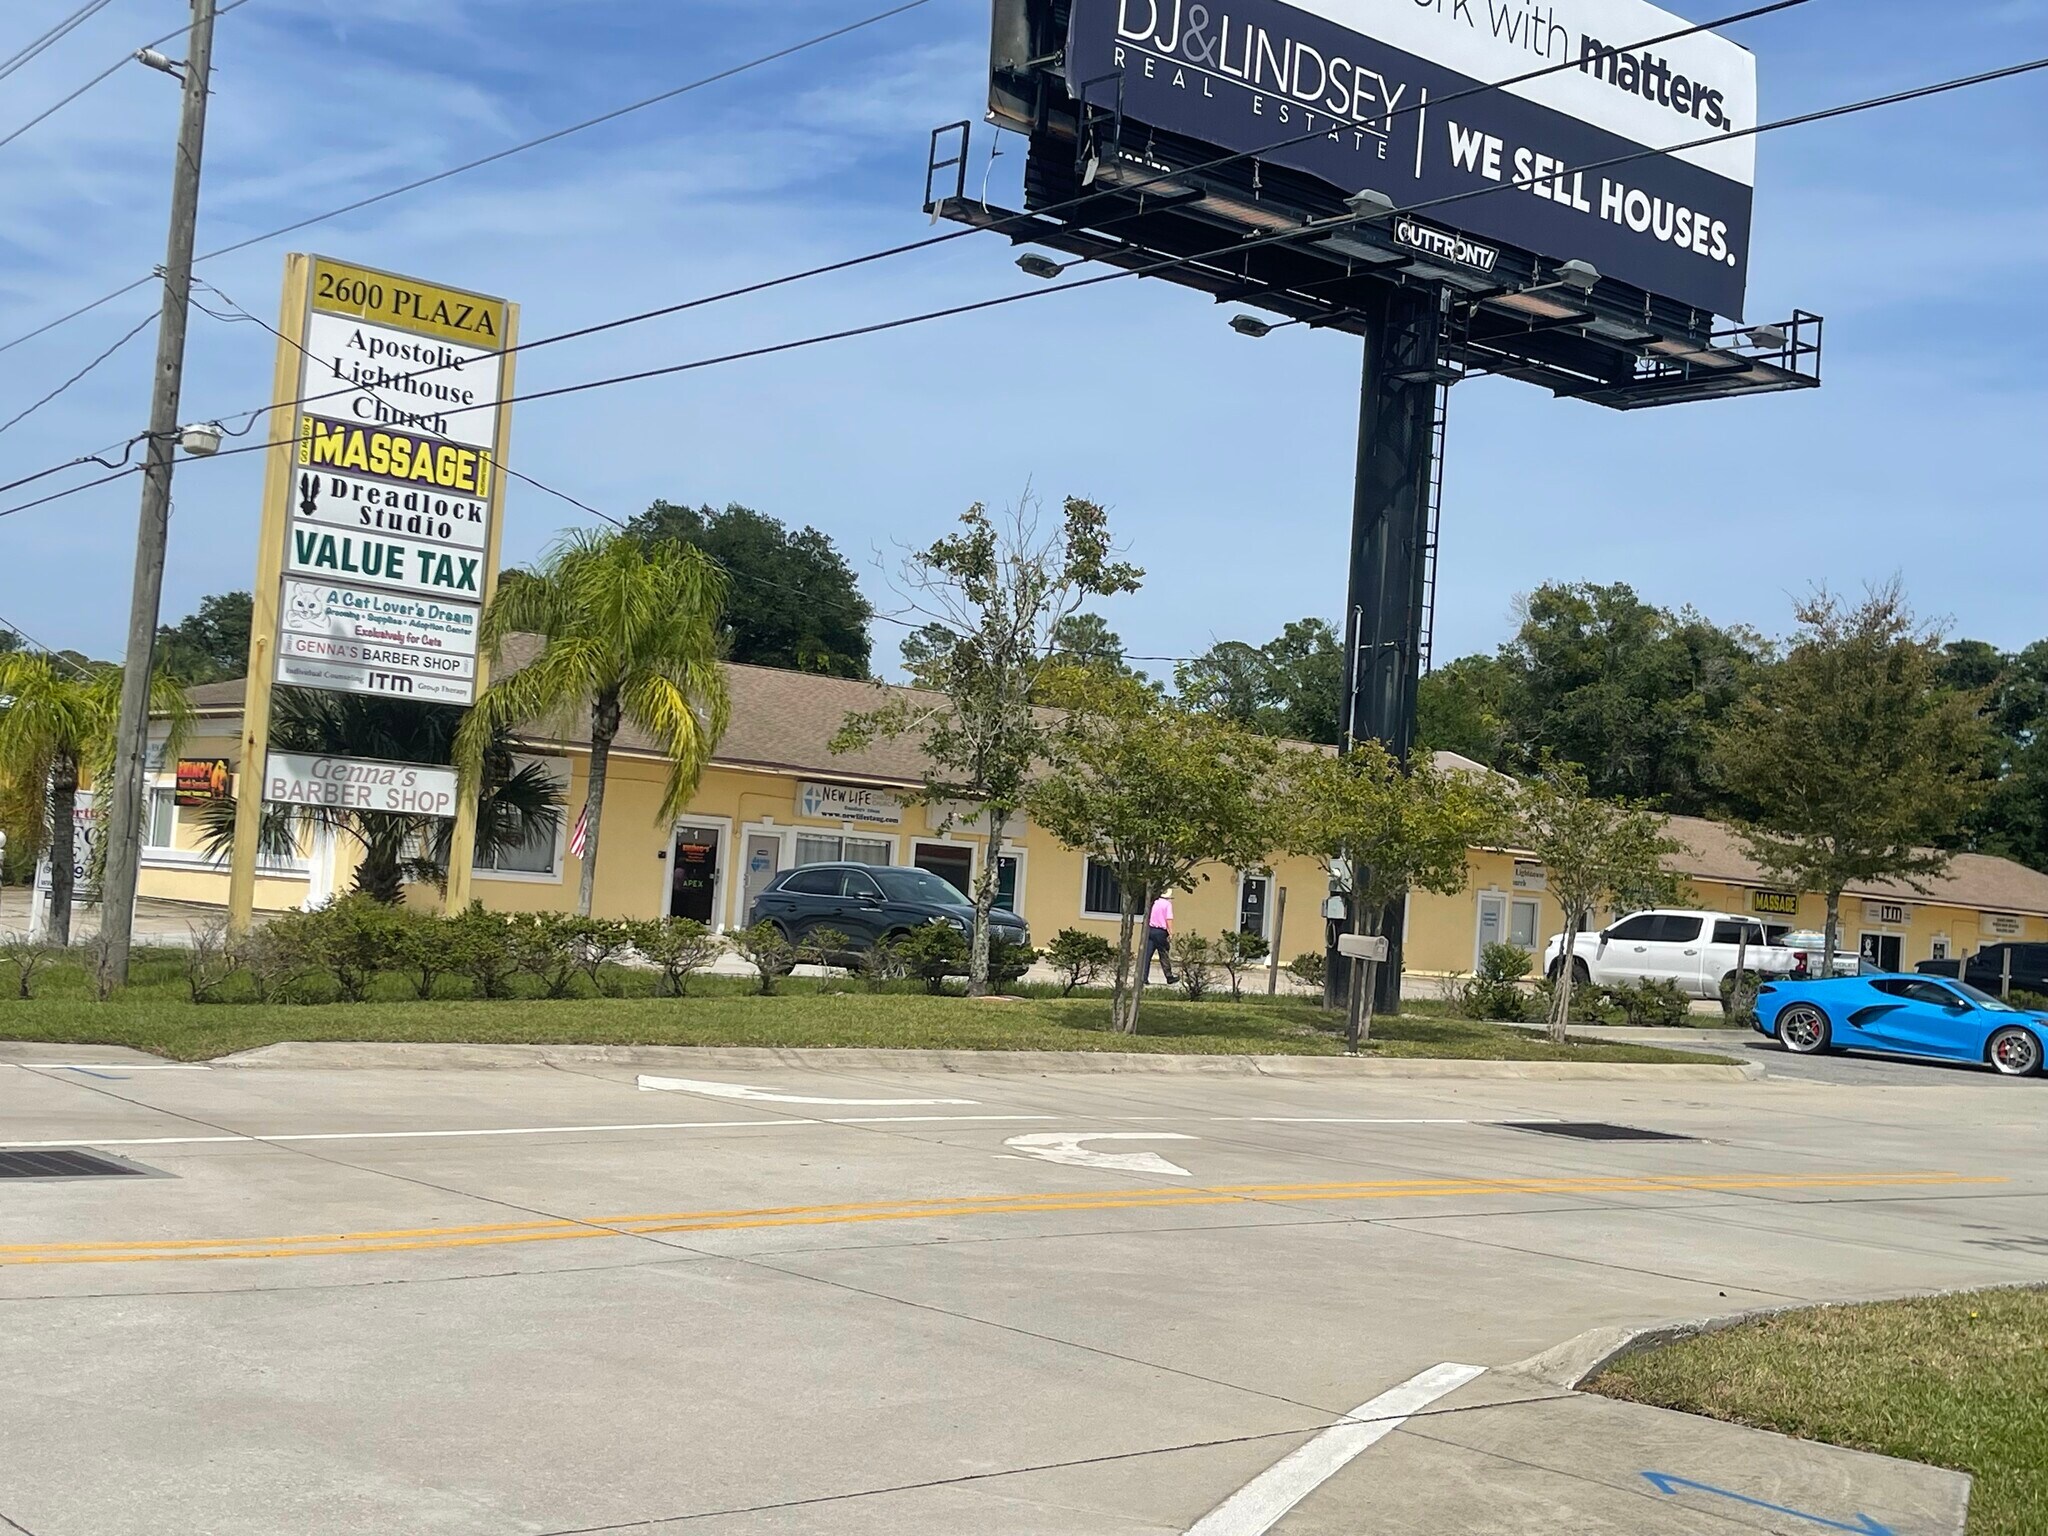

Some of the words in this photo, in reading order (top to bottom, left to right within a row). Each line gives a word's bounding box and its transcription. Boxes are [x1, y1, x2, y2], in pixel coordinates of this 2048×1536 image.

[1488, 0, 1569, 64] with
[1580, 33, 1731, 132] matters.
[1114, 46, 1213, 98] REAL
[1253, 95, 1387, 160] ESTATE
[1448, 121, 1504, 182] WE
[1511, 147, 1591, 213] SELL
[1600, 177, 1736, 267] HOUSES.
[318, 272, 383, 309] 2600
[391, 288, 496, 337] PLAZA
[346, 329, 465, 371] Apostolic
[331, 357, 474, 405] Lighthouse
[353, 396, 448, 435] Church
[313, 421, 477, 491] MASSAGE
[331, 478, 483, 523] Dreadlock
[360, 505, 452, 539] Studio
[295, 529, 406, 580] VALUE
[417, 549, 479, 592] TAX
[326, 590, 340, 605] A
[342, 591, 370, 610] Cat
[373, 596, 425, 617] Lover's
[428, 604, 474, 625] Dream
[295, 639, 359, 659] GENNA'S
[362, 648, 420, 667] BARBER
[422, 656, 461, 672] SHOP
[406, 633, 421, 644] for
[421, 636, 443, 648] Cats
[311, 758, 418, 787] Genna's
[271, 778, 372, 808] BARBER
[386, 787, 450, 812] SHOP
[822, 786, 847, 802] NEW
[849, 790, 872, 806] LIFE
[693, 830, 699, 840] 1
[1000, 858, 1006, 868] 2
[682, 880, 704, 888] APEX
[1251, 881, 1257, 890] 3
[1755, 892, 1797, 912] MASSAGE
